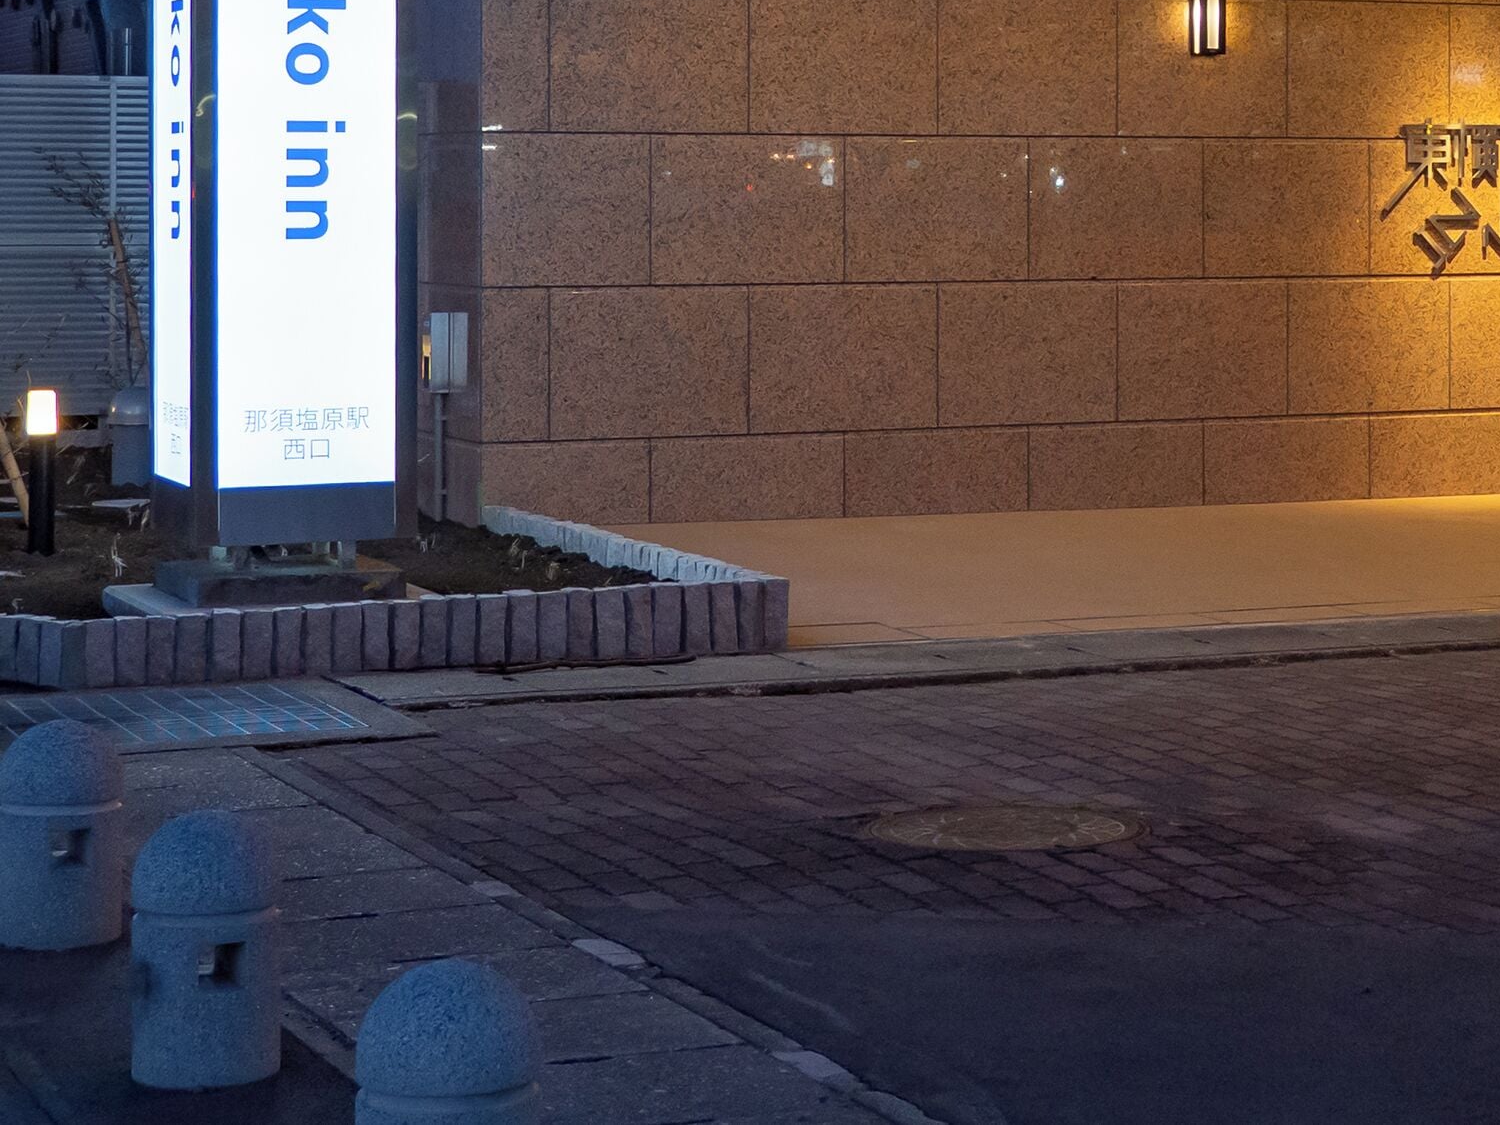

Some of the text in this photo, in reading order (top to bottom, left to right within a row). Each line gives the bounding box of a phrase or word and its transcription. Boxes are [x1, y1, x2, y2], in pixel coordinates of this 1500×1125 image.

[170, 121, 184, 240] inn
[286, 120, 346, 240] inn
[244, 406, 370, 433] 那須塩原駅
[284, 438, 330, 460] 西口
